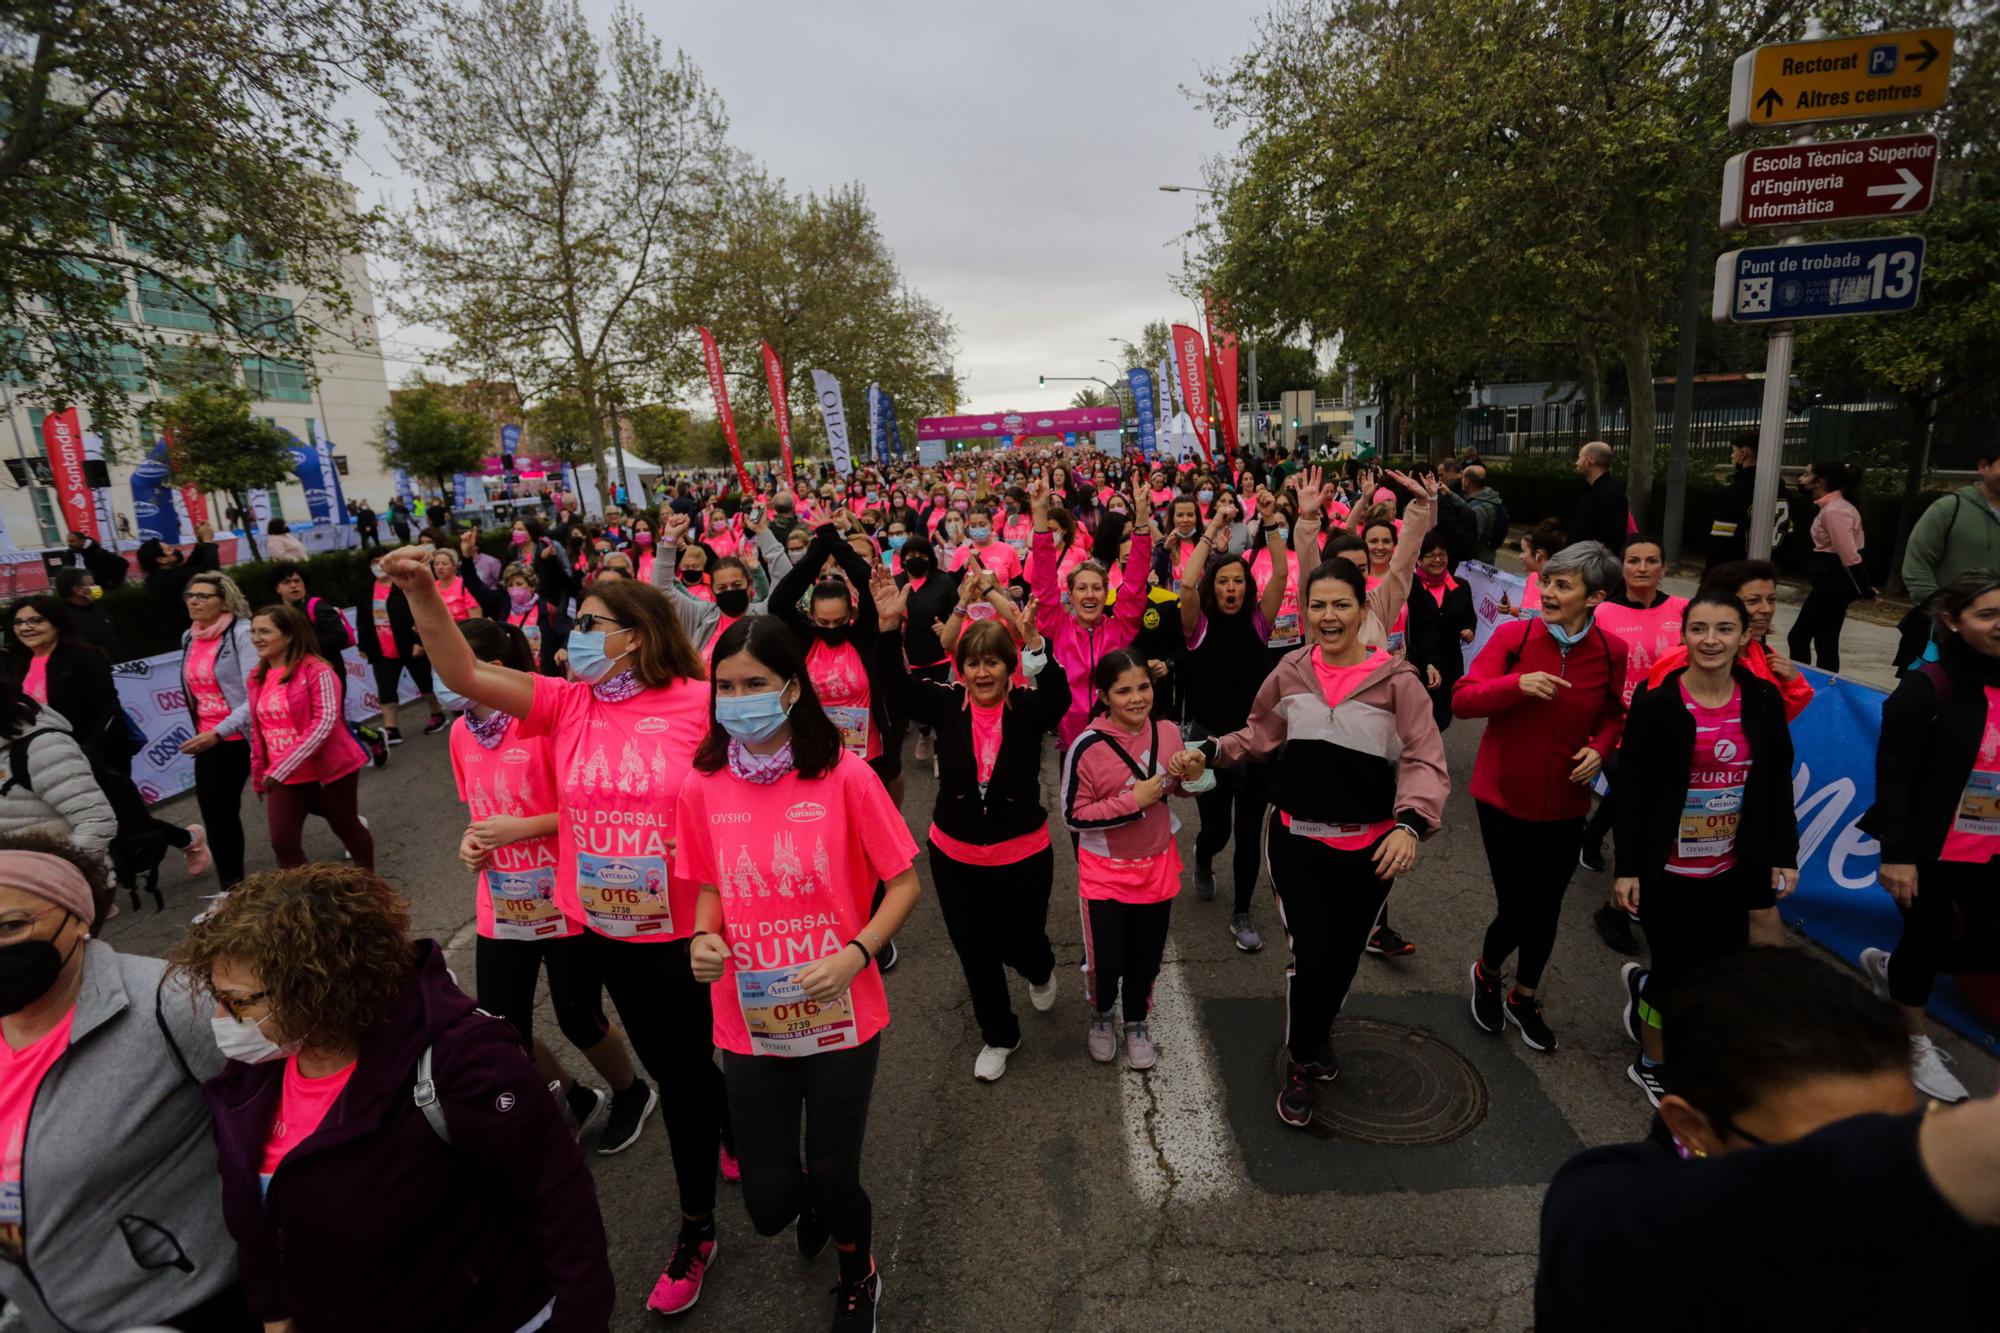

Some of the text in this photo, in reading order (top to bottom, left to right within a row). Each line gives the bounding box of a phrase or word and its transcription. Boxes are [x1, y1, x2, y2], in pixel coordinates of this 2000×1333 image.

[1782, 54, 1858, 76] Rectorat
[1796, 83, 1922, 109] Altres centres
[1752, 142, 1934, 173] Escola Tècnica Superior
[1750, 173, 1844, 197] d'Enginyeria
[1748, 198, 1834, 219] Informàtica
[1741, 252, 1861, 275] Punt de trobada
[1867, 251, 1916, 300] 13
[54, 421, 84, 491] Santander
[1771, 500, 1789, 547] 2
[157, 691, 191, 711] COS
[1717, 743, 1733, 759] Z
[569, 807, 668, 828] TU DORSAL
[711, 812, 751, 824] OYSHO
[1706, 813, 1737, 828] 016
[572, 824, 667, 856] SUMA
[492, 844, 557, 869] UMA
[506, 899, 534, 911] 016
[601, 888, 637, 904] 016
[729, 912, 840, 939] TU DORSAL
[732, 928, 844, 970] SUMA
[770, 985, 801, 995] ASTURI
[773, 1000, 819, 1021] 016
[787, 1020, 810, 1031] 2739
[761, 1042, 791, 1051] OYSHO
